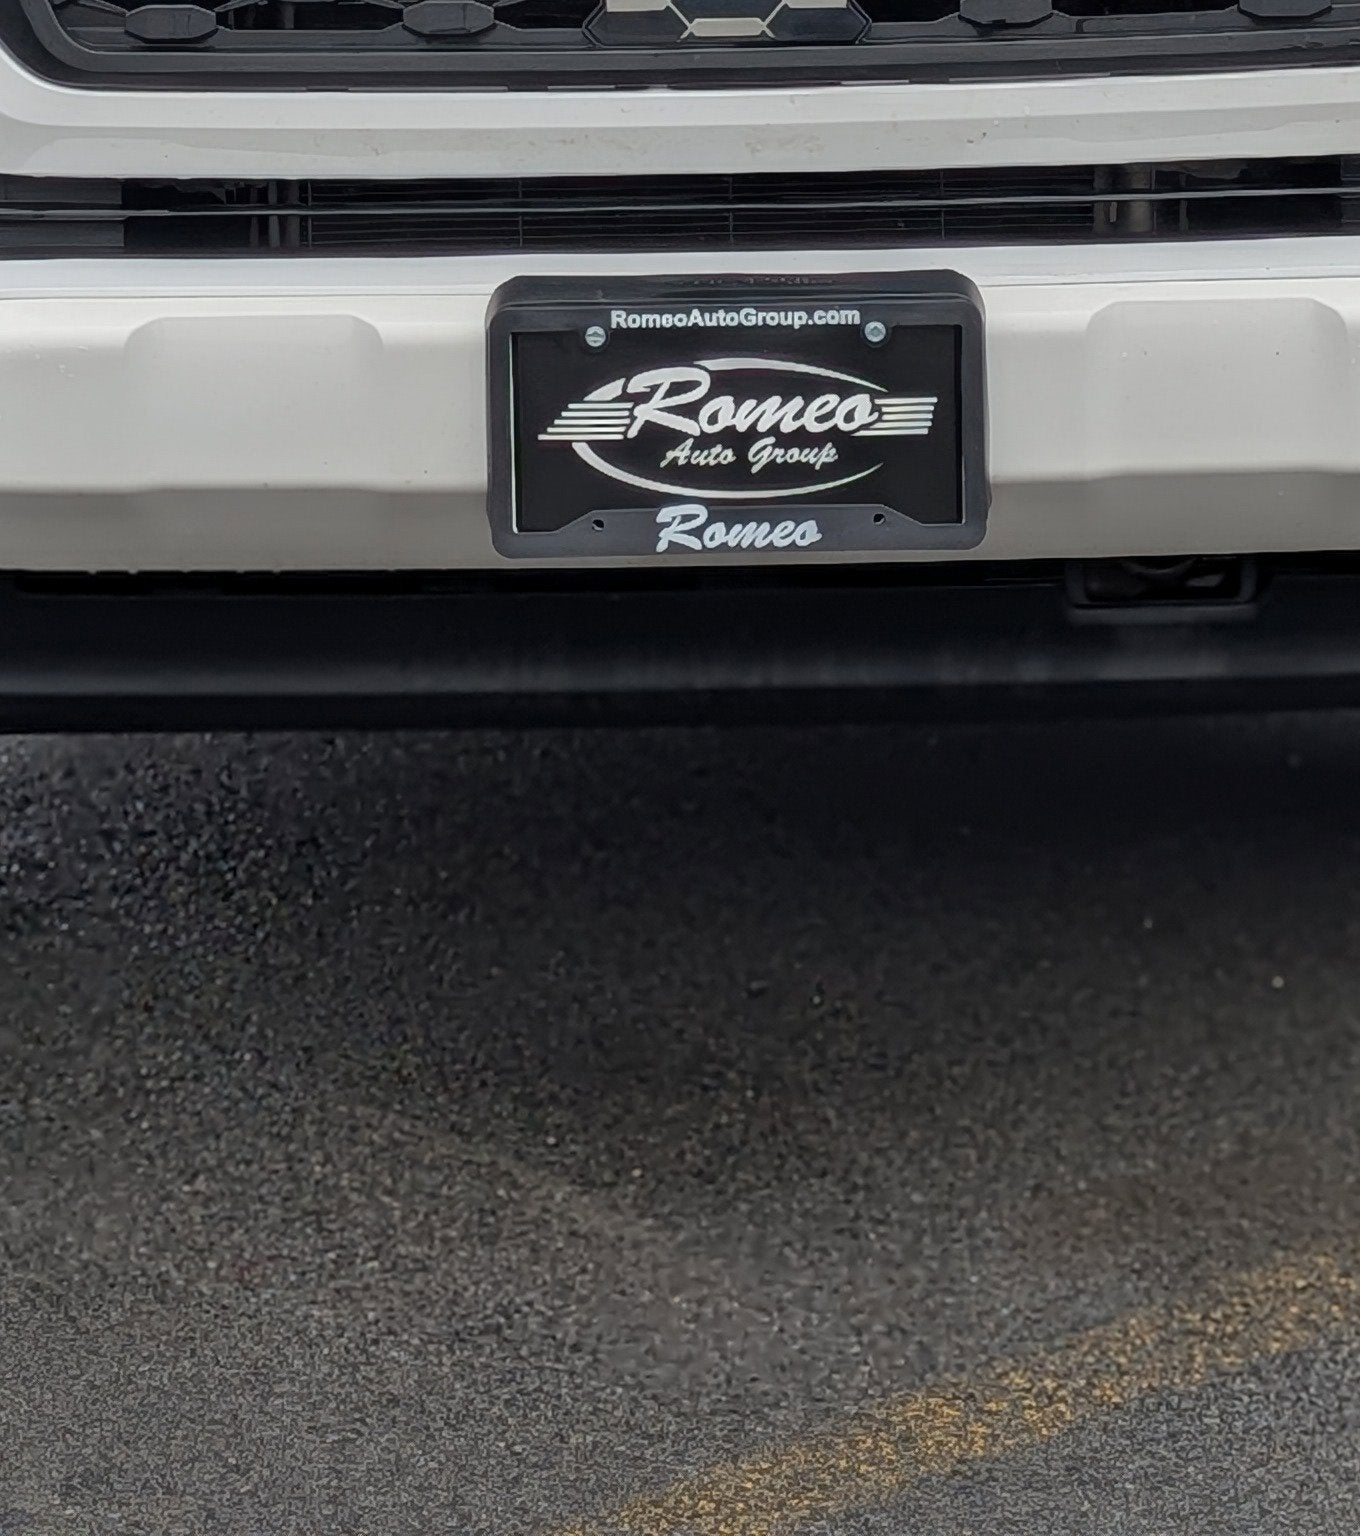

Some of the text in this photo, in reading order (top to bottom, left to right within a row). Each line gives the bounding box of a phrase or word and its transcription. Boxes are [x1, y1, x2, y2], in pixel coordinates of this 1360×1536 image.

[610, 307, 861, 330] RomeoAutoGroup.com
[626, 366, 880, 438] Romeo
[660, 436, 838, 474] Auto Group
[655, 503, 822, 553] Romeo
